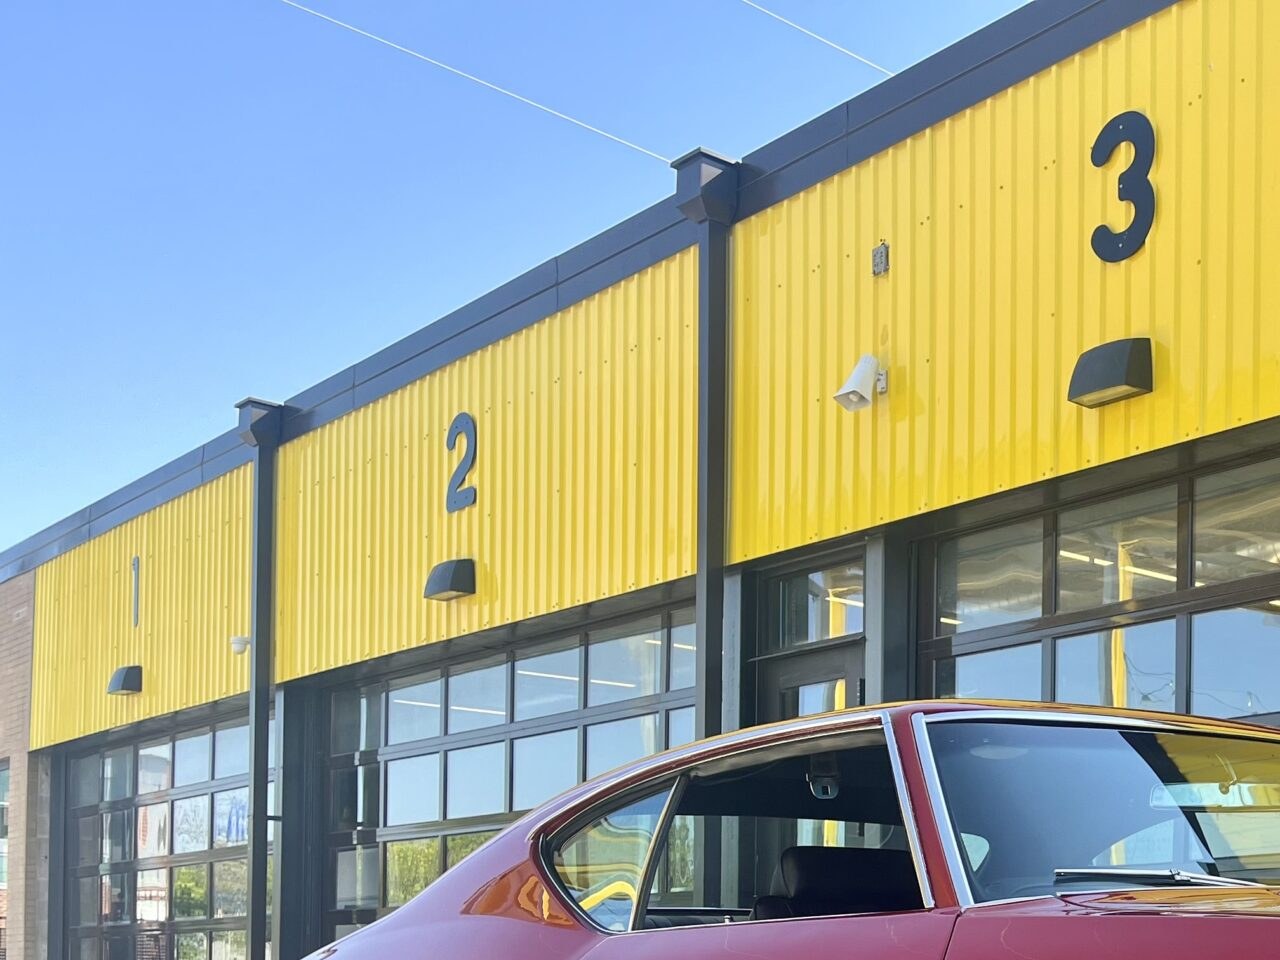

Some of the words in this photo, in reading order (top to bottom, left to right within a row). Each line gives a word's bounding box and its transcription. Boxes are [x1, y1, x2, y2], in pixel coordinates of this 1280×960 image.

[1090, 110, 1156, 263] 3
[446, 411, 477, 513] 2
[132, 555, 140, 627] 1
